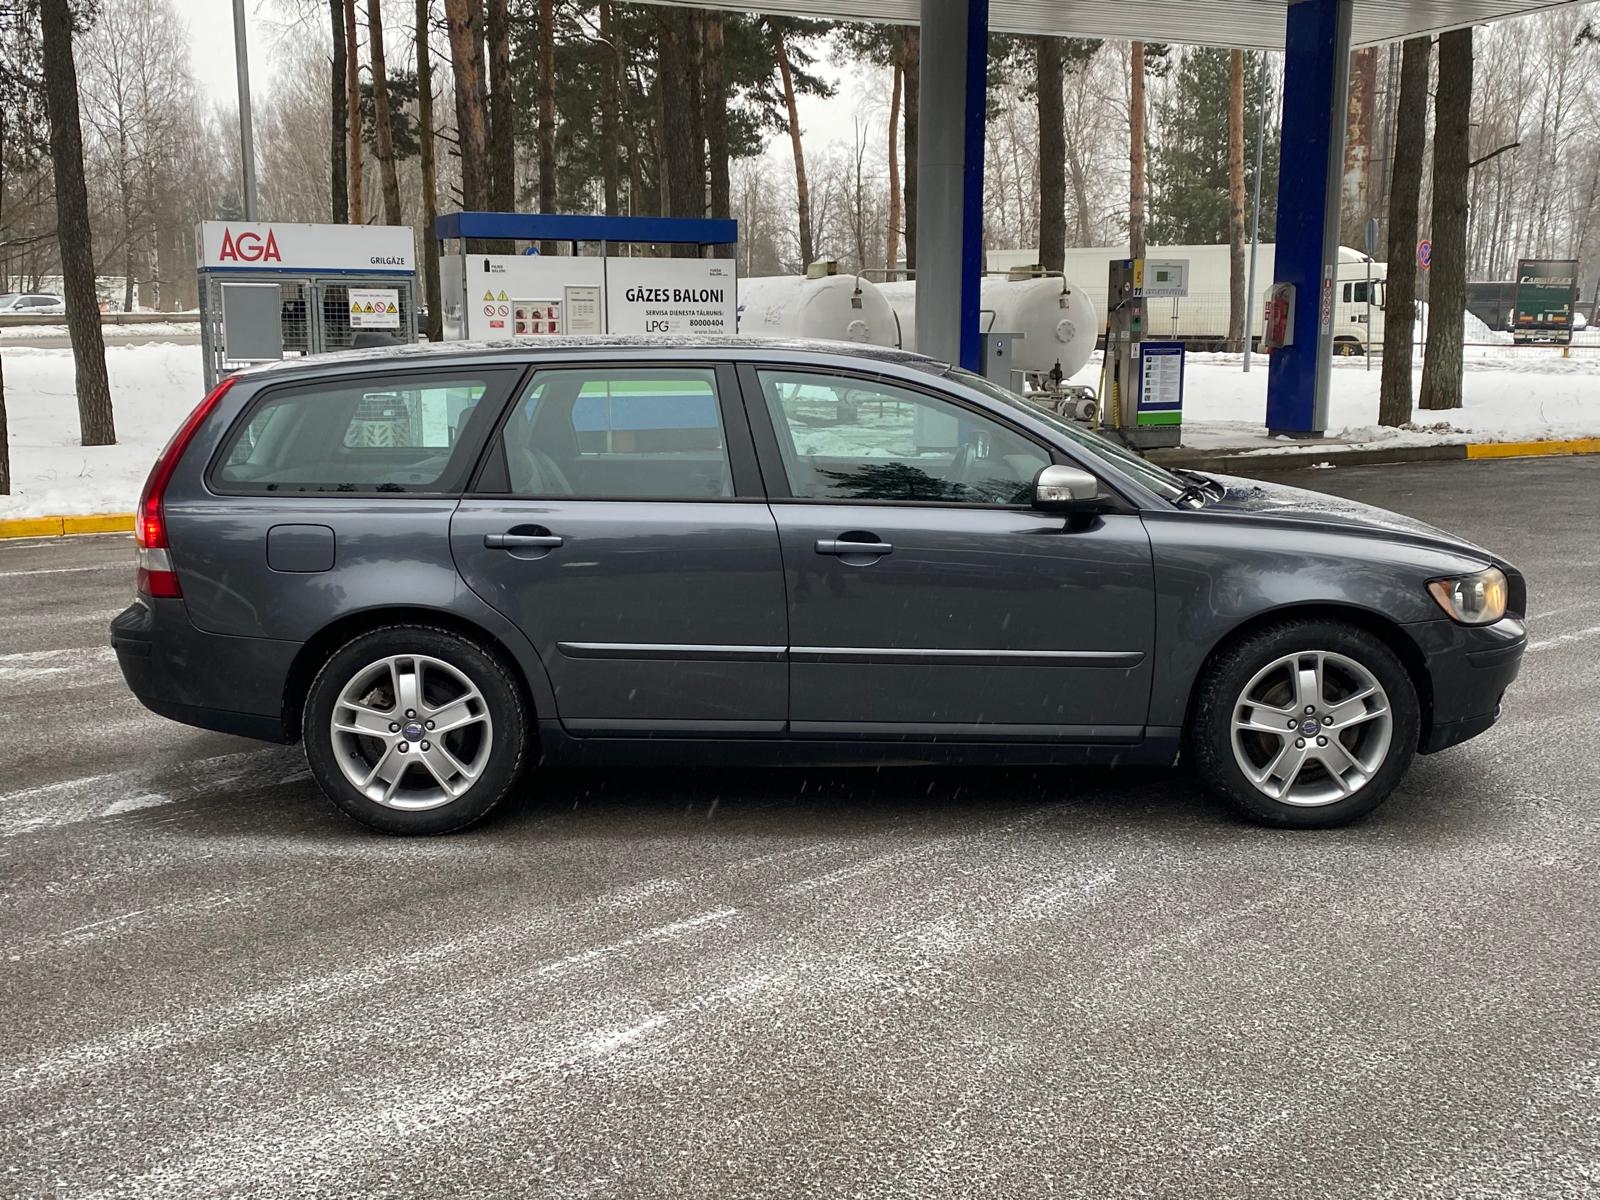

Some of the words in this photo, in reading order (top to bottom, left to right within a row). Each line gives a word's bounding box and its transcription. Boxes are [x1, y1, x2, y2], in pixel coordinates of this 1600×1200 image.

[219, 226, 282, 262] AGA
[625, 286, 670, 302] GĀZES
[673, 288, 724, 302] BALONI
[646, 320, 669, 333] LPG
[689, 319, 724, 327] 80000404
